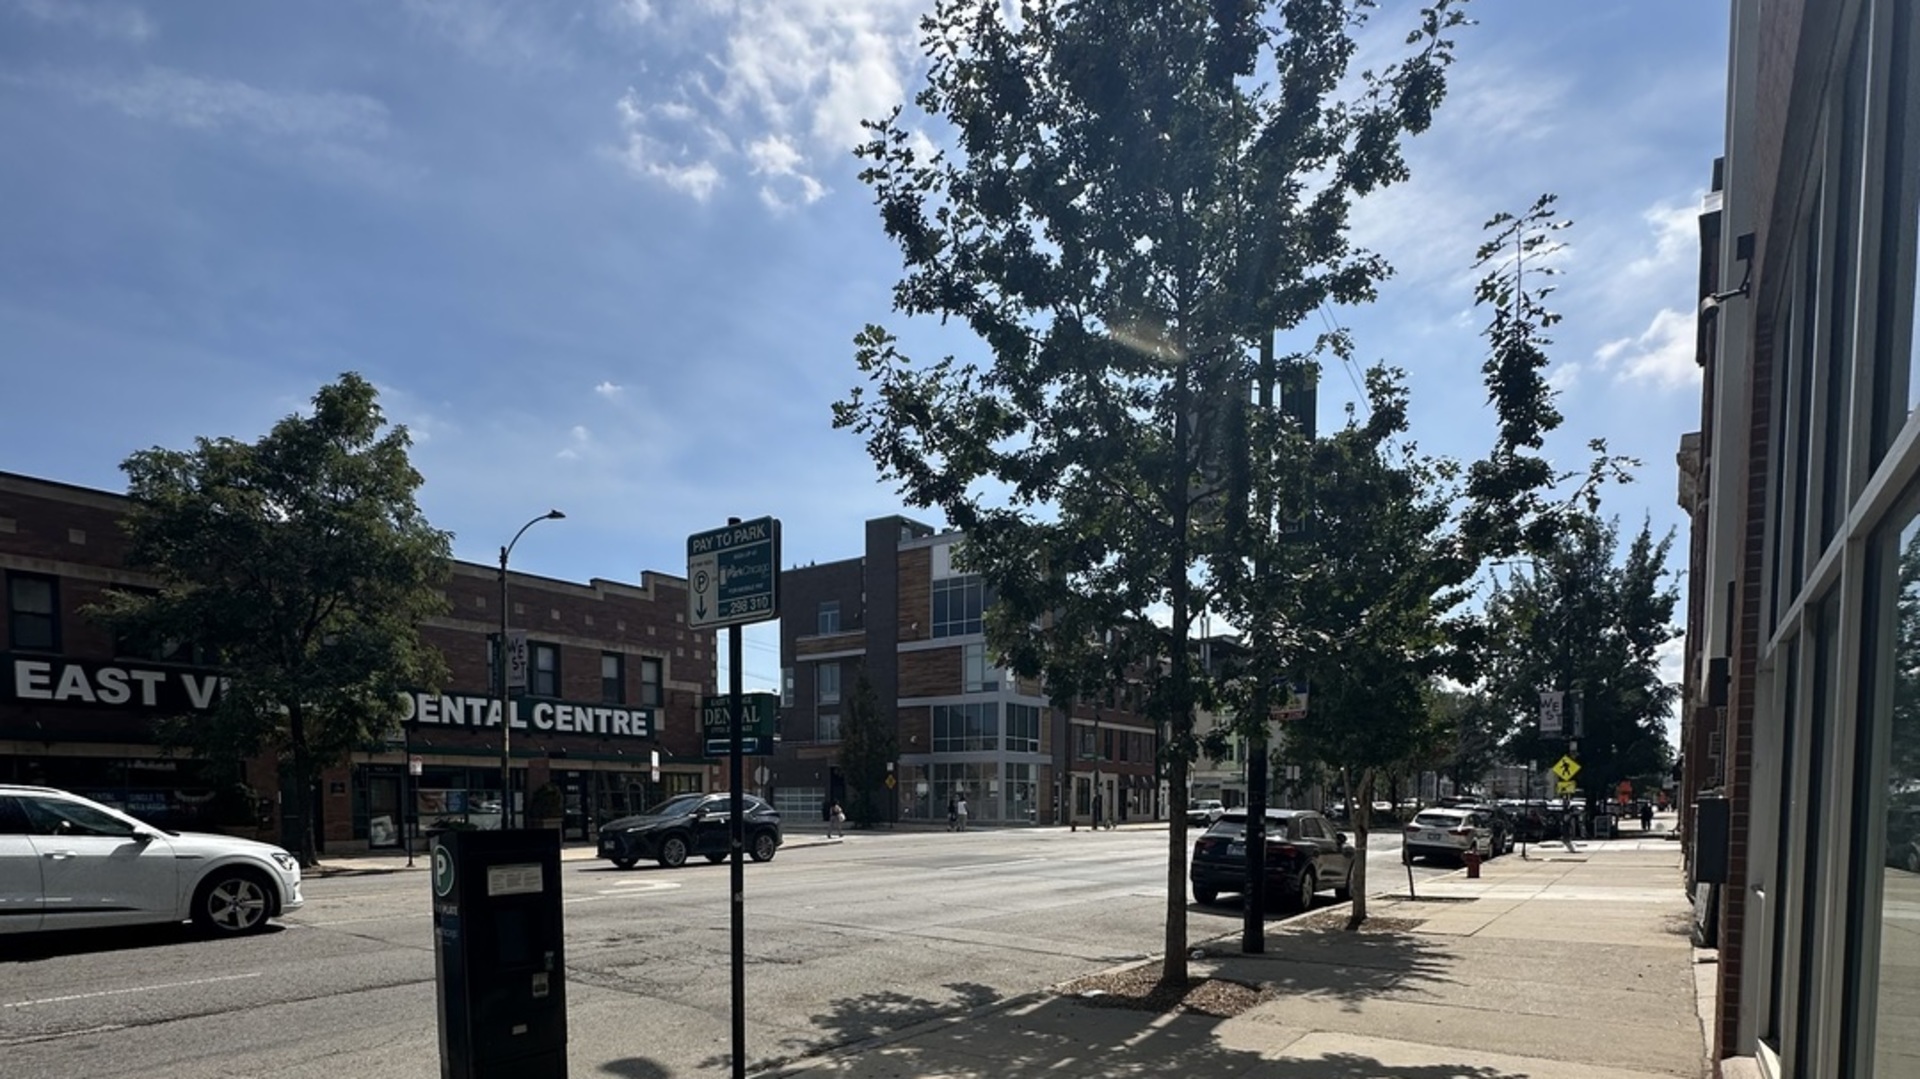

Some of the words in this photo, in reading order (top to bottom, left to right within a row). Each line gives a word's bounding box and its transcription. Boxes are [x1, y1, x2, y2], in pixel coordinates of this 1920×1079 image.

[693, 536, 714, 554] PAY
[716, 533, 731, 547] TO
[734, 523, 766, 544] PARK
[14, 660, 166, 706] EAST
[397, 691, 527, 730] DENTAL
[532, 701, 648, 736] CENTRE
[704, 705, 761, 726] DENAL
